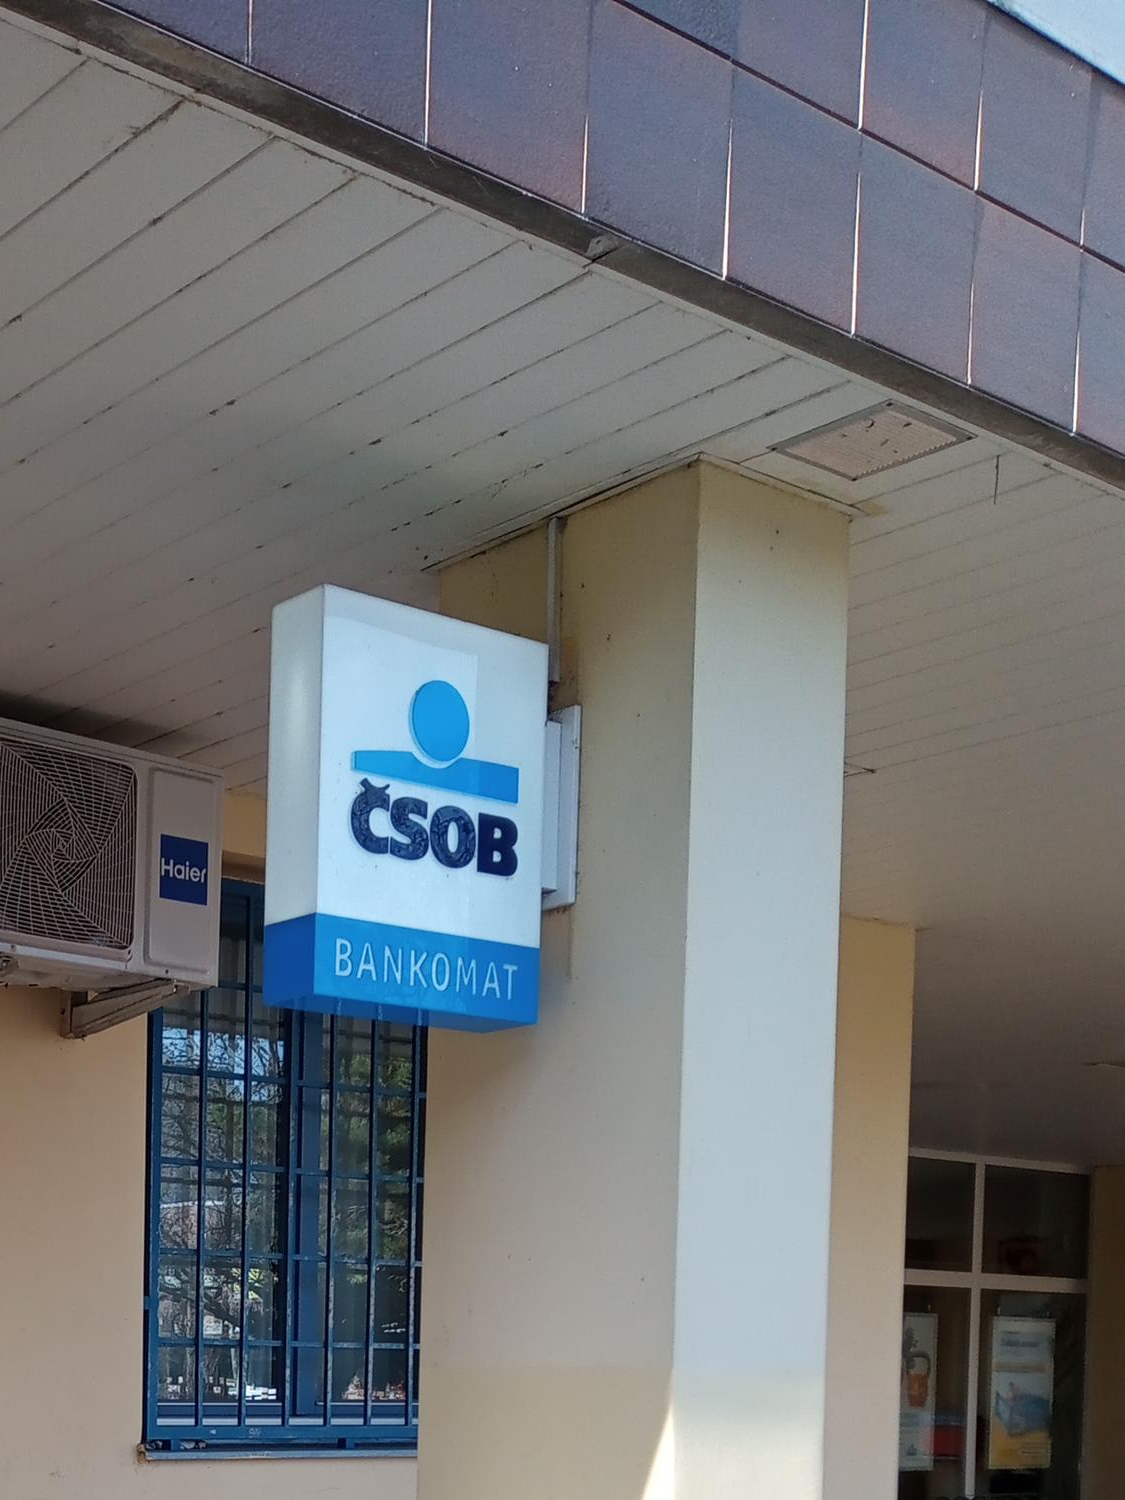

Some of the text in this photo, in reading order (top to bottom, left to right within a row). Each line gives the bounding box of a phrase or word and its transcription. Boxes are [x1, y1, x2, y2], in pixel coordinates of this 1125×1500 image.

[350, 777, 518, 877] ČSOB
[161, 857, 206, 883] Haier
[334, 937, 517, 1001] BANKOMAT
